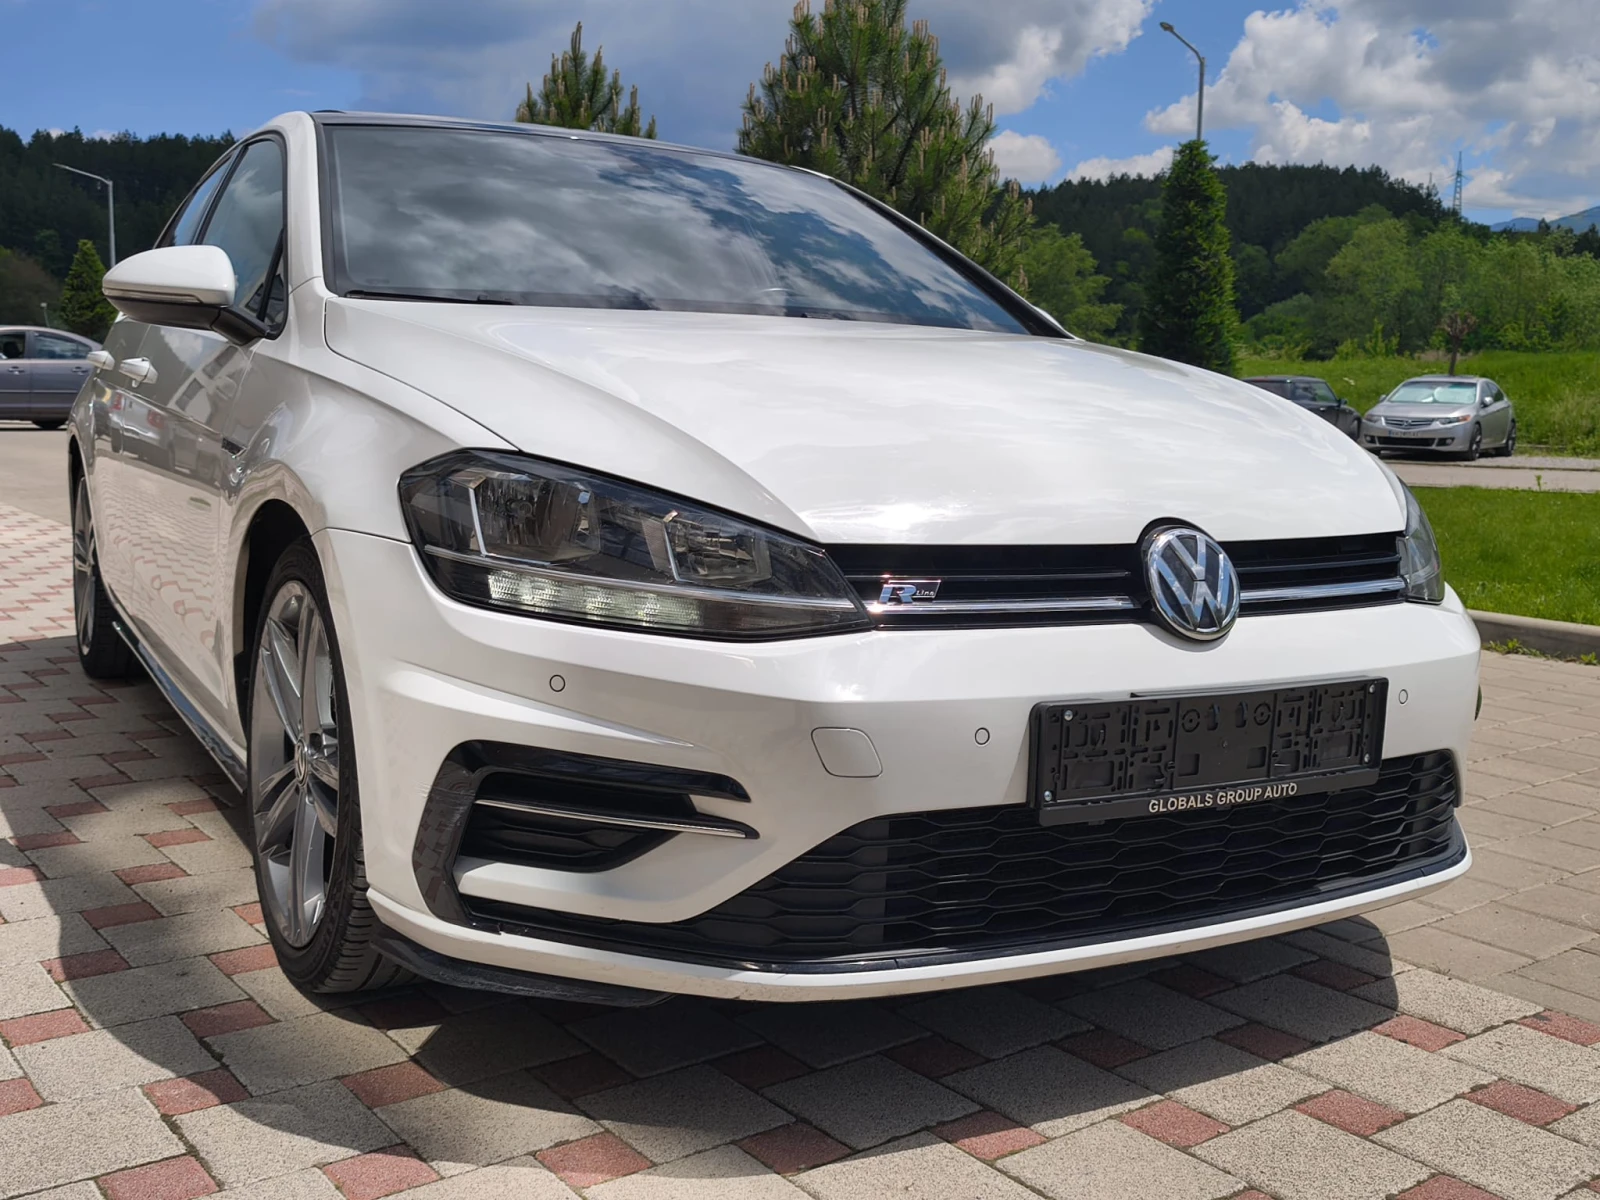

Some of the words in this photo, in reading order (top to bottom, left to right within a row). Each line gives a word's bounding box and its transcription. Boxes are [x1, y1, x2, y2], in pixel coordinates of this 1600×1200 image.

[879, 584, 917, 603] R
[1150, 530, 1237, 634] VW
[1148, 793, 1213, 813] GLOBALS
[1216, 787, 1262, 805] GROUP
[1263, 782, 1298, 799] AUTO
